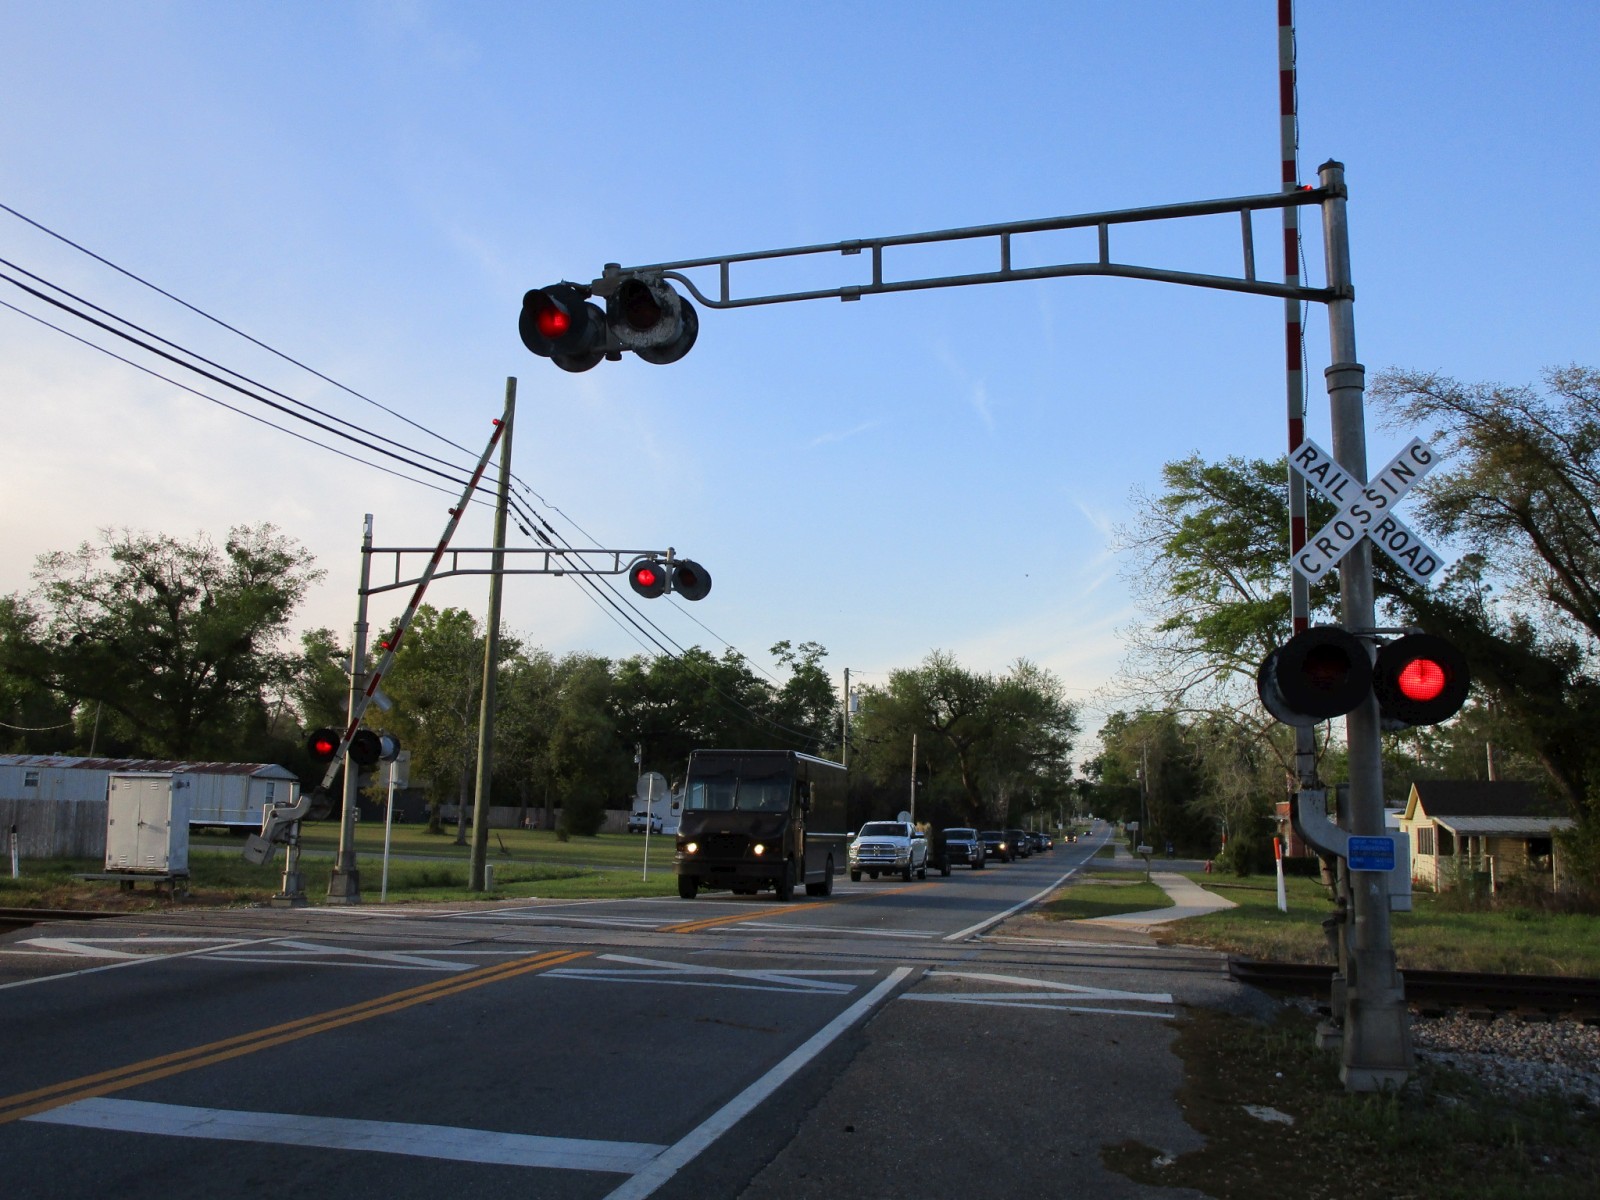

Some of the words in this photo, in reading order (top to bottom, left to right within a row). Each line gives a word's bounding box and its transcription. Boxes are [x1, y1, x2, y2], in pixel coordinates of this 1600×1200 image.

[1295, 446, 1349, 502] RAIL
[1373, 517, 1436, 576] ROAD
[1299, 445, 1432, 574] CROSSING
